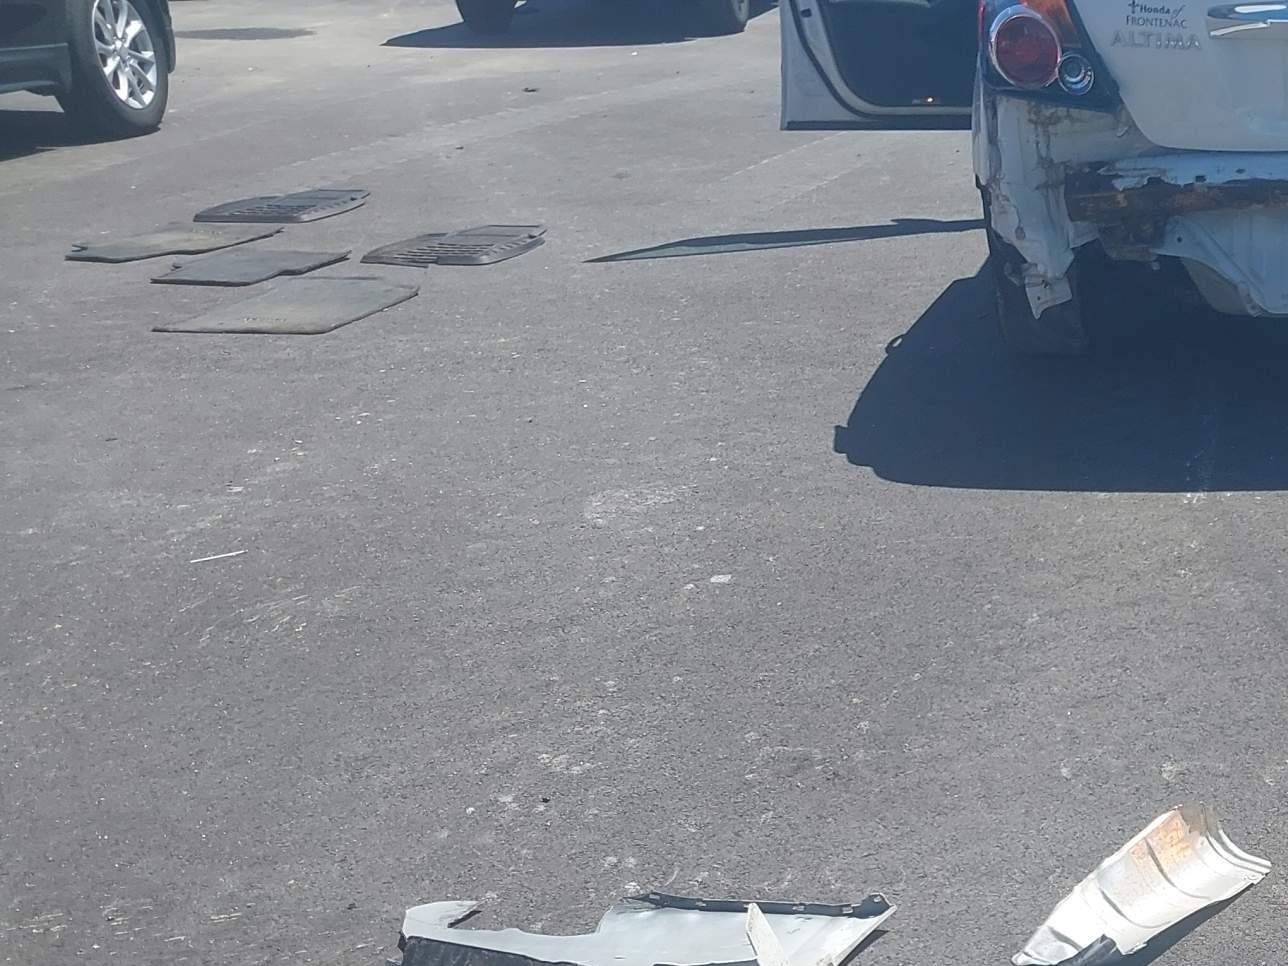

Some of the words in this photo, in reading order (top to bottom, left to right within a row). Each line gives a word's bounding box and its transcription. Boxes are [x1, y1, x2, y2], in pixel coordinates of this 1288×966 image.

[1140, 4, 1170, 15] Honda
[1126, 15, 1188, 28] FRONTENAC
[1111, 29, 1202, 50] ALTIMA
